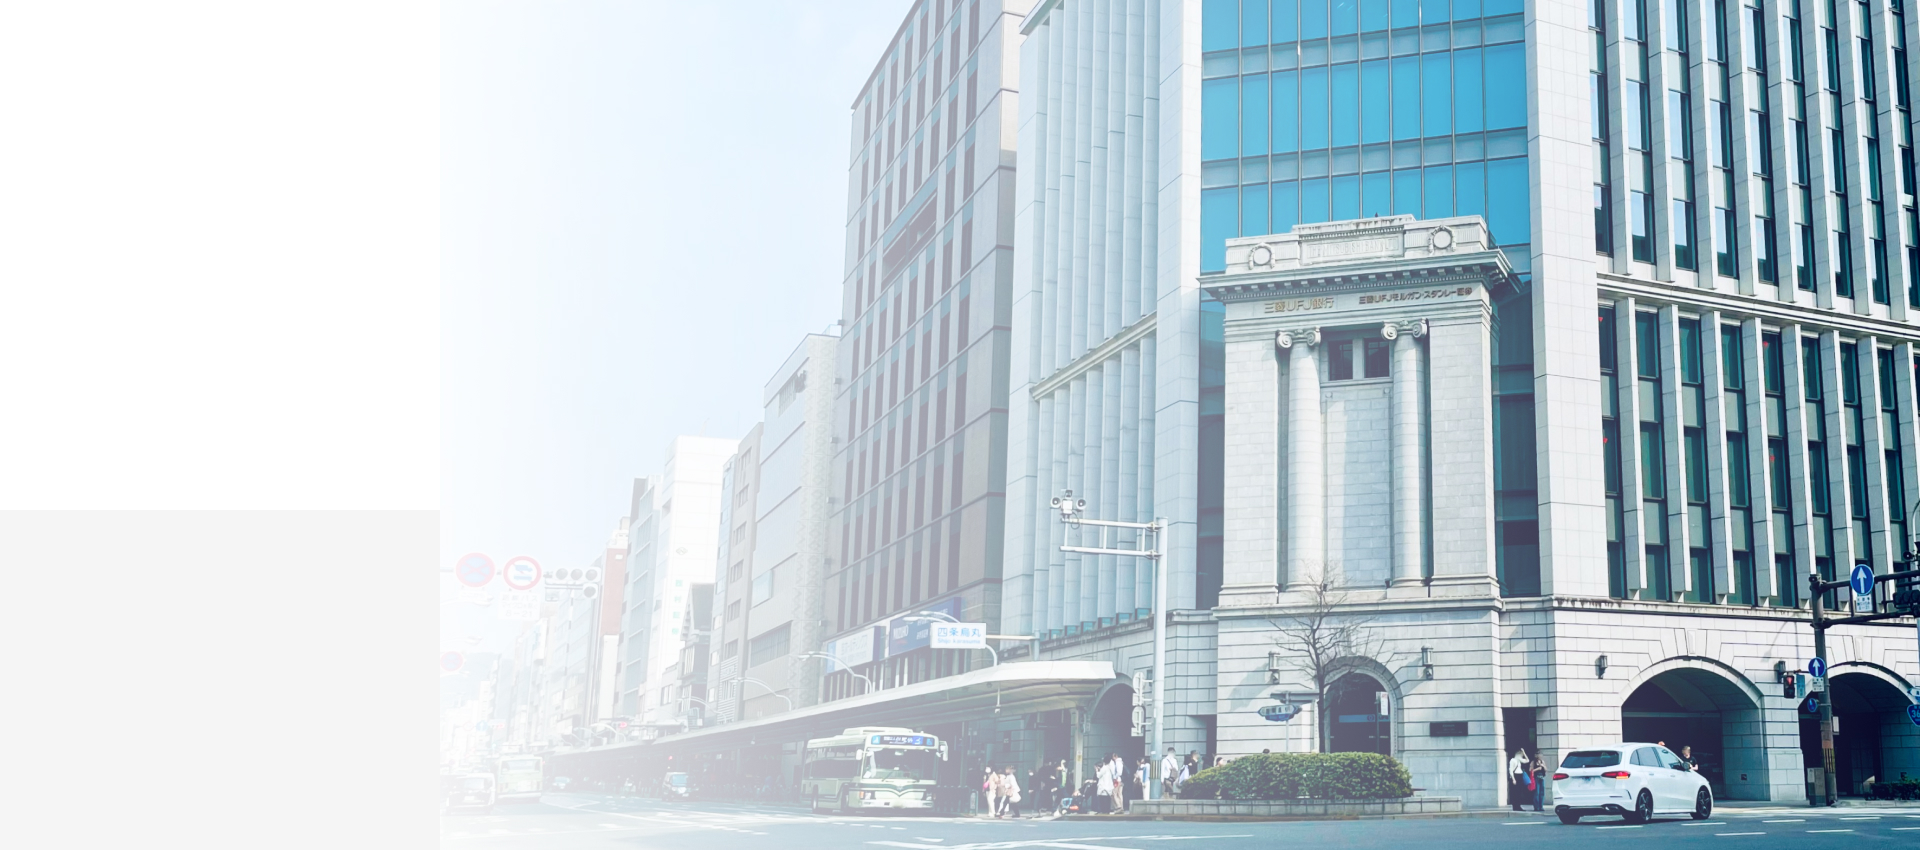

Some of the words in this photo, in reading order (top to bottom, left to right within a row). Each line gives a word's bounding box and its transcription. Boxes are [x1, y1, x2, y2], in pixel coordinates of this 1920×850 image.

[1323, 240, 1364, 256] MITSUBISHI
[1365, 239, 1384, 252] BANK
[1264, 297, 1334, 314] 三菱UFJ銀行
[937, 627, 981, 637] 四条烏丸
